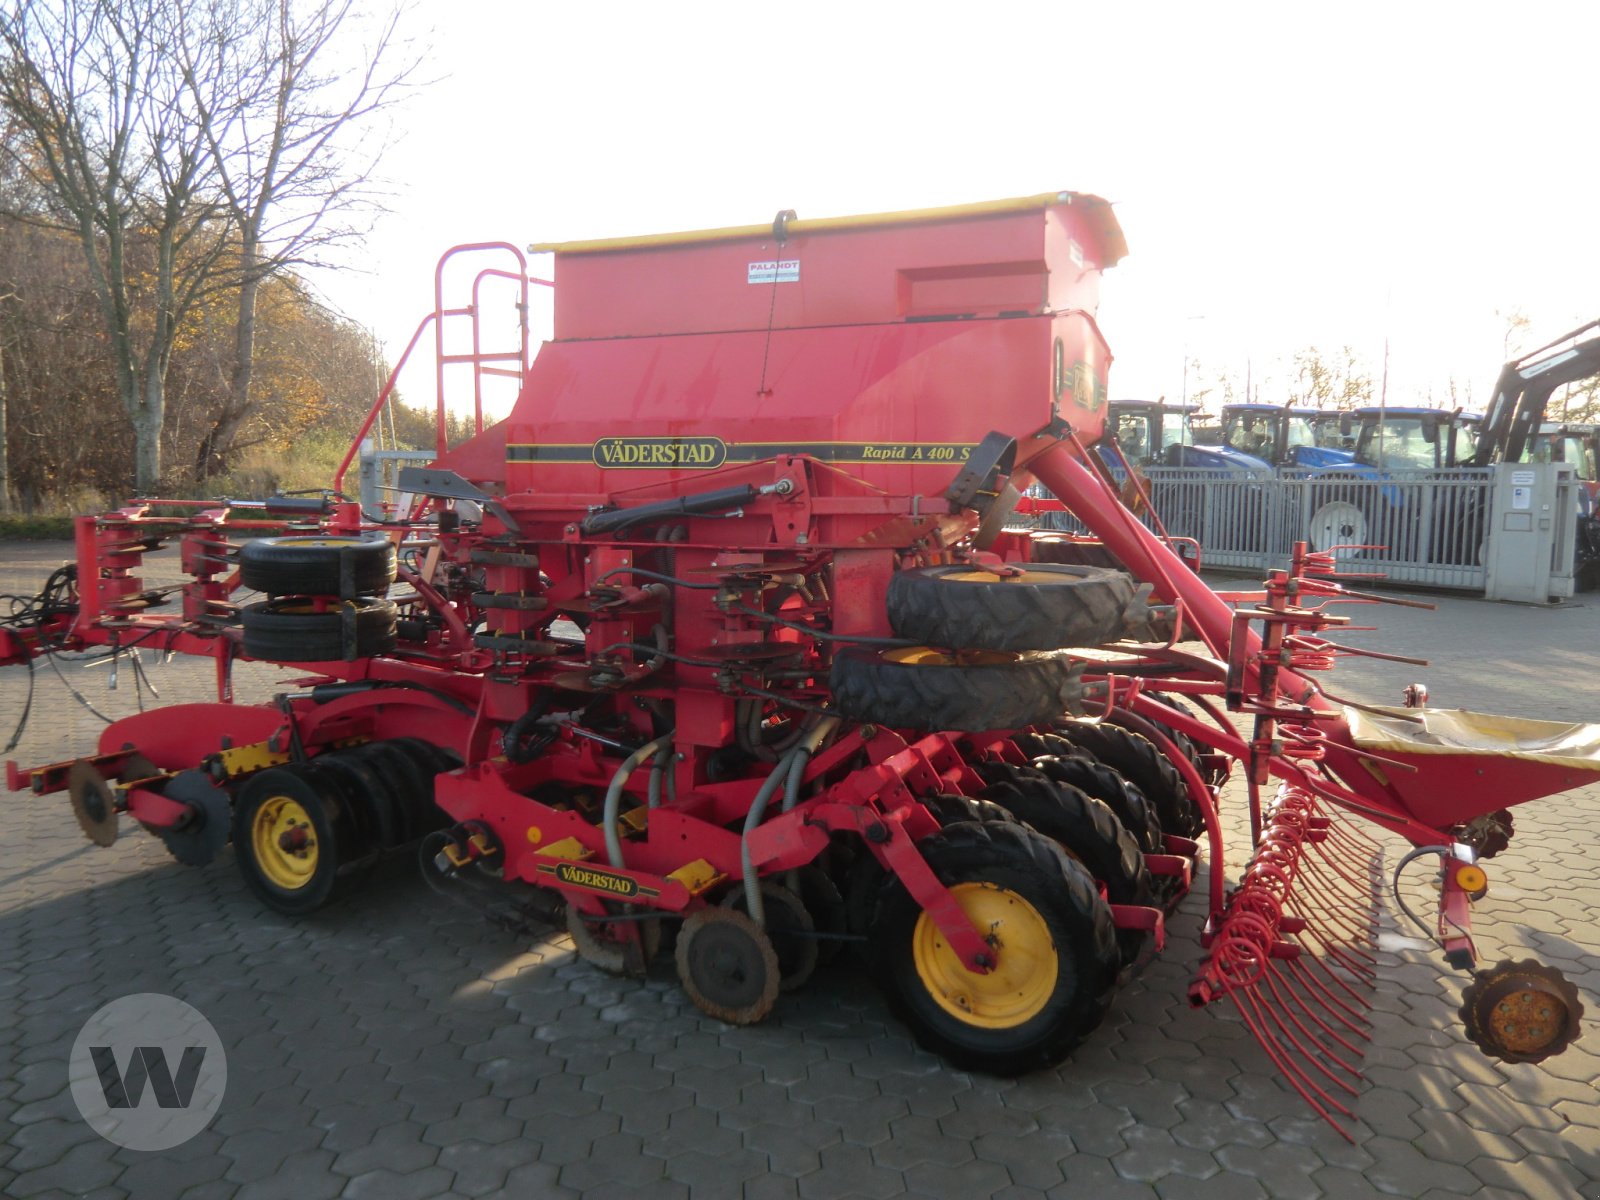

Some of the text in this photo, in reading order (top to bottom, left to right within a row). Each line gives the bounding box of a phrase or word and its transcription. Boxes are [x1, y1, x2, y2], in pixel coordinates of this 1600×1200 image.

[601, 440, 716, 463] VÄDERSTAD
[862, 446, 971, 460] Rapid A 400 S
[562, 866, 631, 893] VÄDERSTAD
